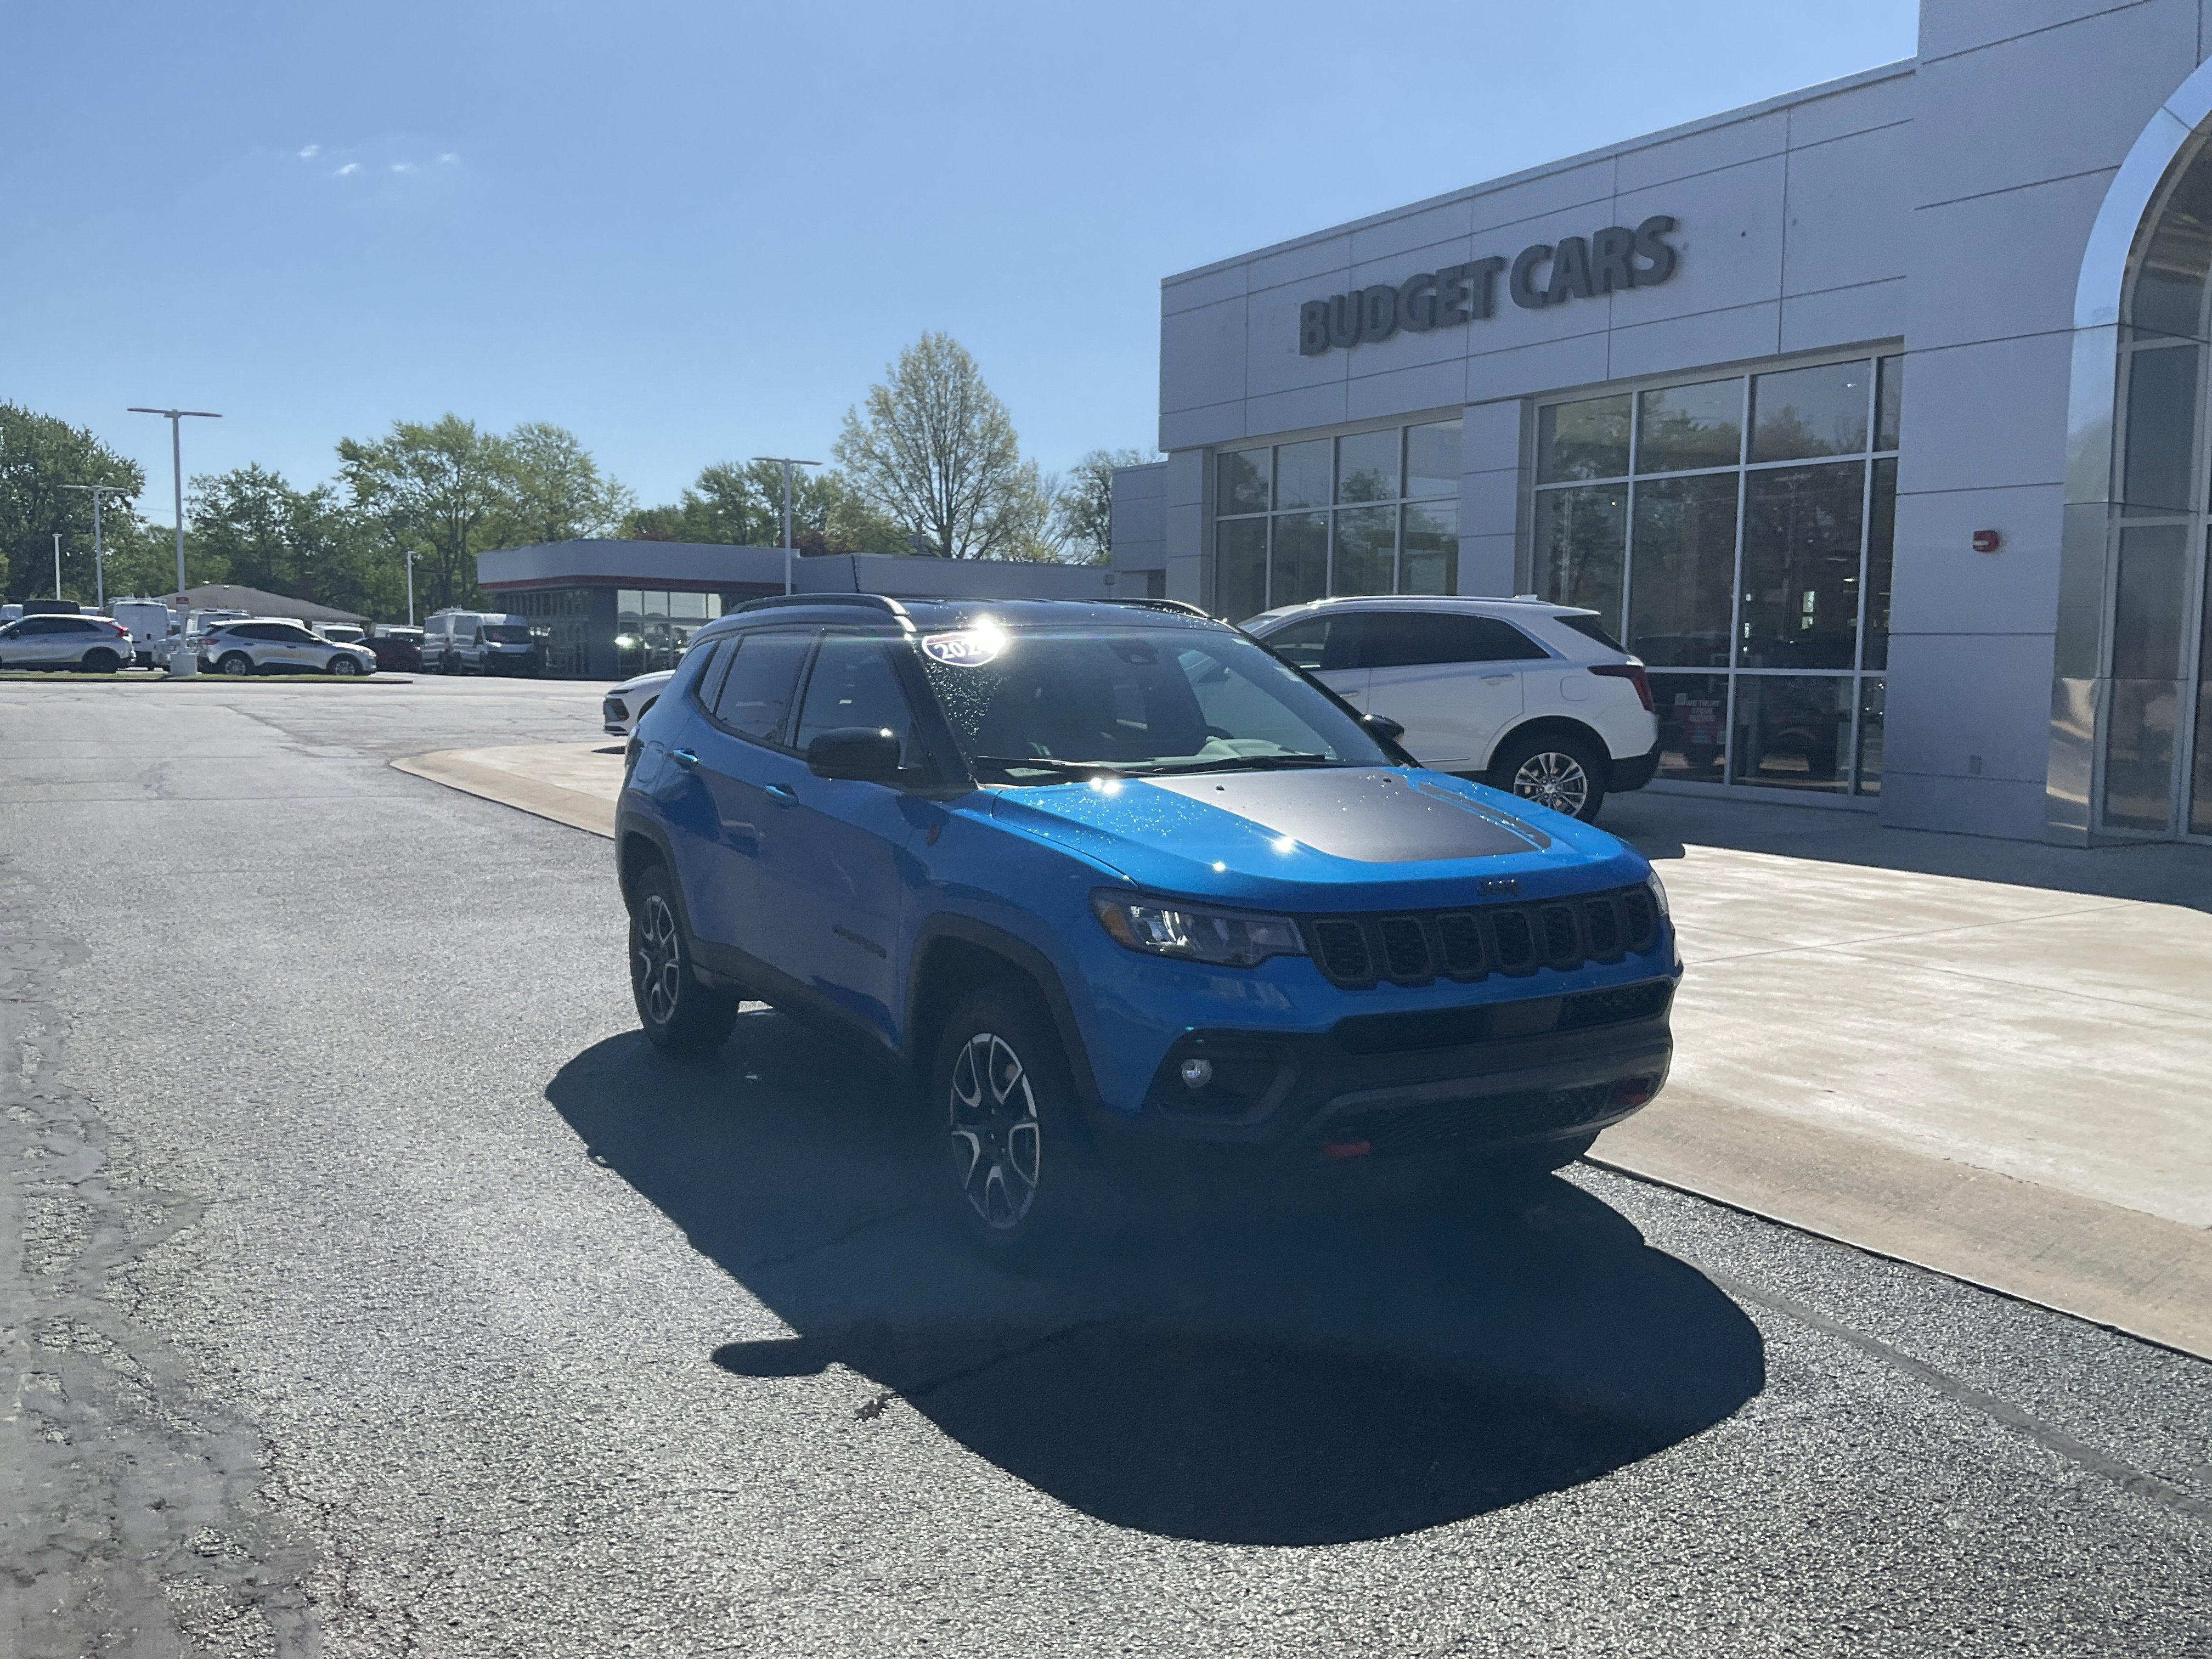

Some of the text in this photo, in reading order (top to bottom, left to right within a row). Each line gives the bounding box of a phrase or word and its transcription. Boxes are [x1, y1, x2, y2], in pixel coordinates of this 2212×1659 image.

[1300, 215, 1677, 356] BUDGET CARS
[934, 639, 994, 659] 202
